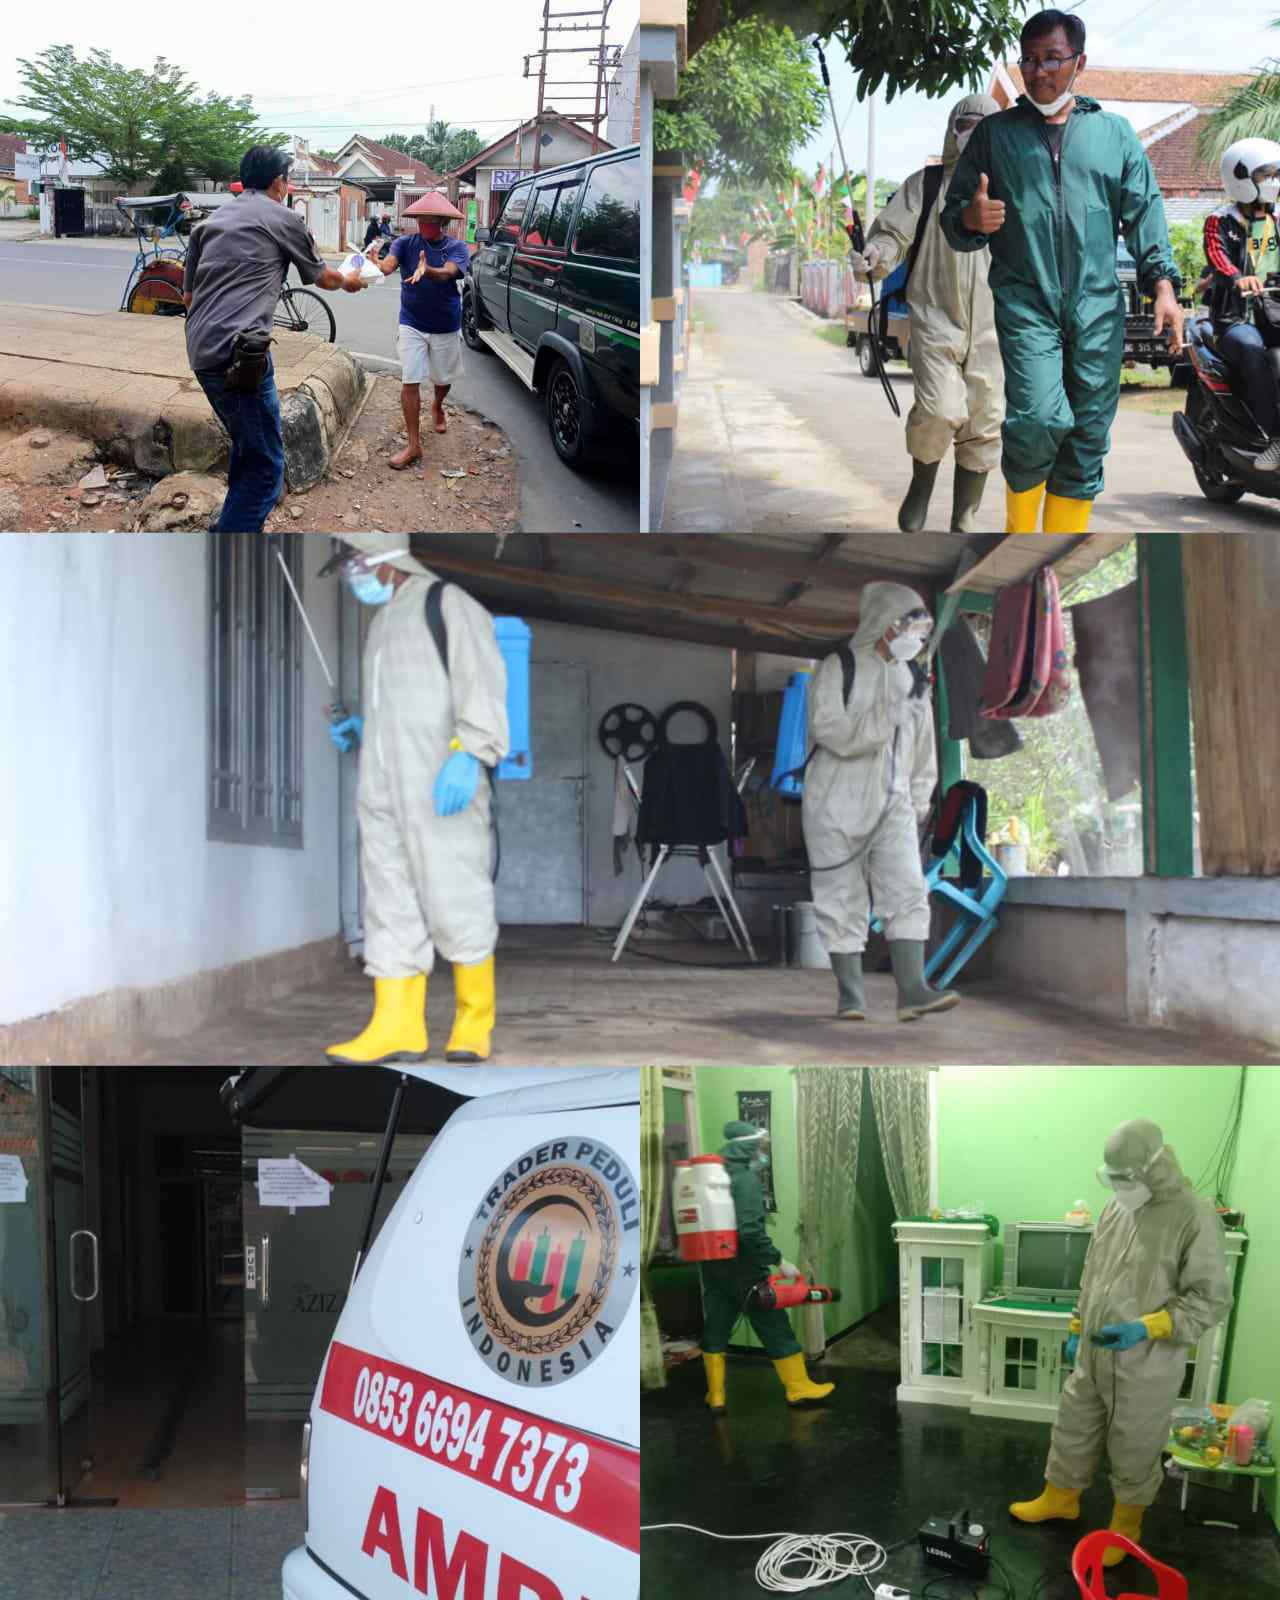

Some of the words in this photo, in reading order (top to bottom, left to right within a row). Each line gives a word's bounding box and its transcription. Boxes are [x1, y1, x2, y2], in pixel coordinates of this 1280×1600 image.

[476, 1141, 569, 1221] TRADER
[576, 1141, 639, 1232] PEDULI
[462, 1296, 614, 1383] INDONESIA
[353, 1366, 414, 1437] 0853
[414, 1389, 492, 1471] 6694
[491, 1416, 590, 1513] 7373
